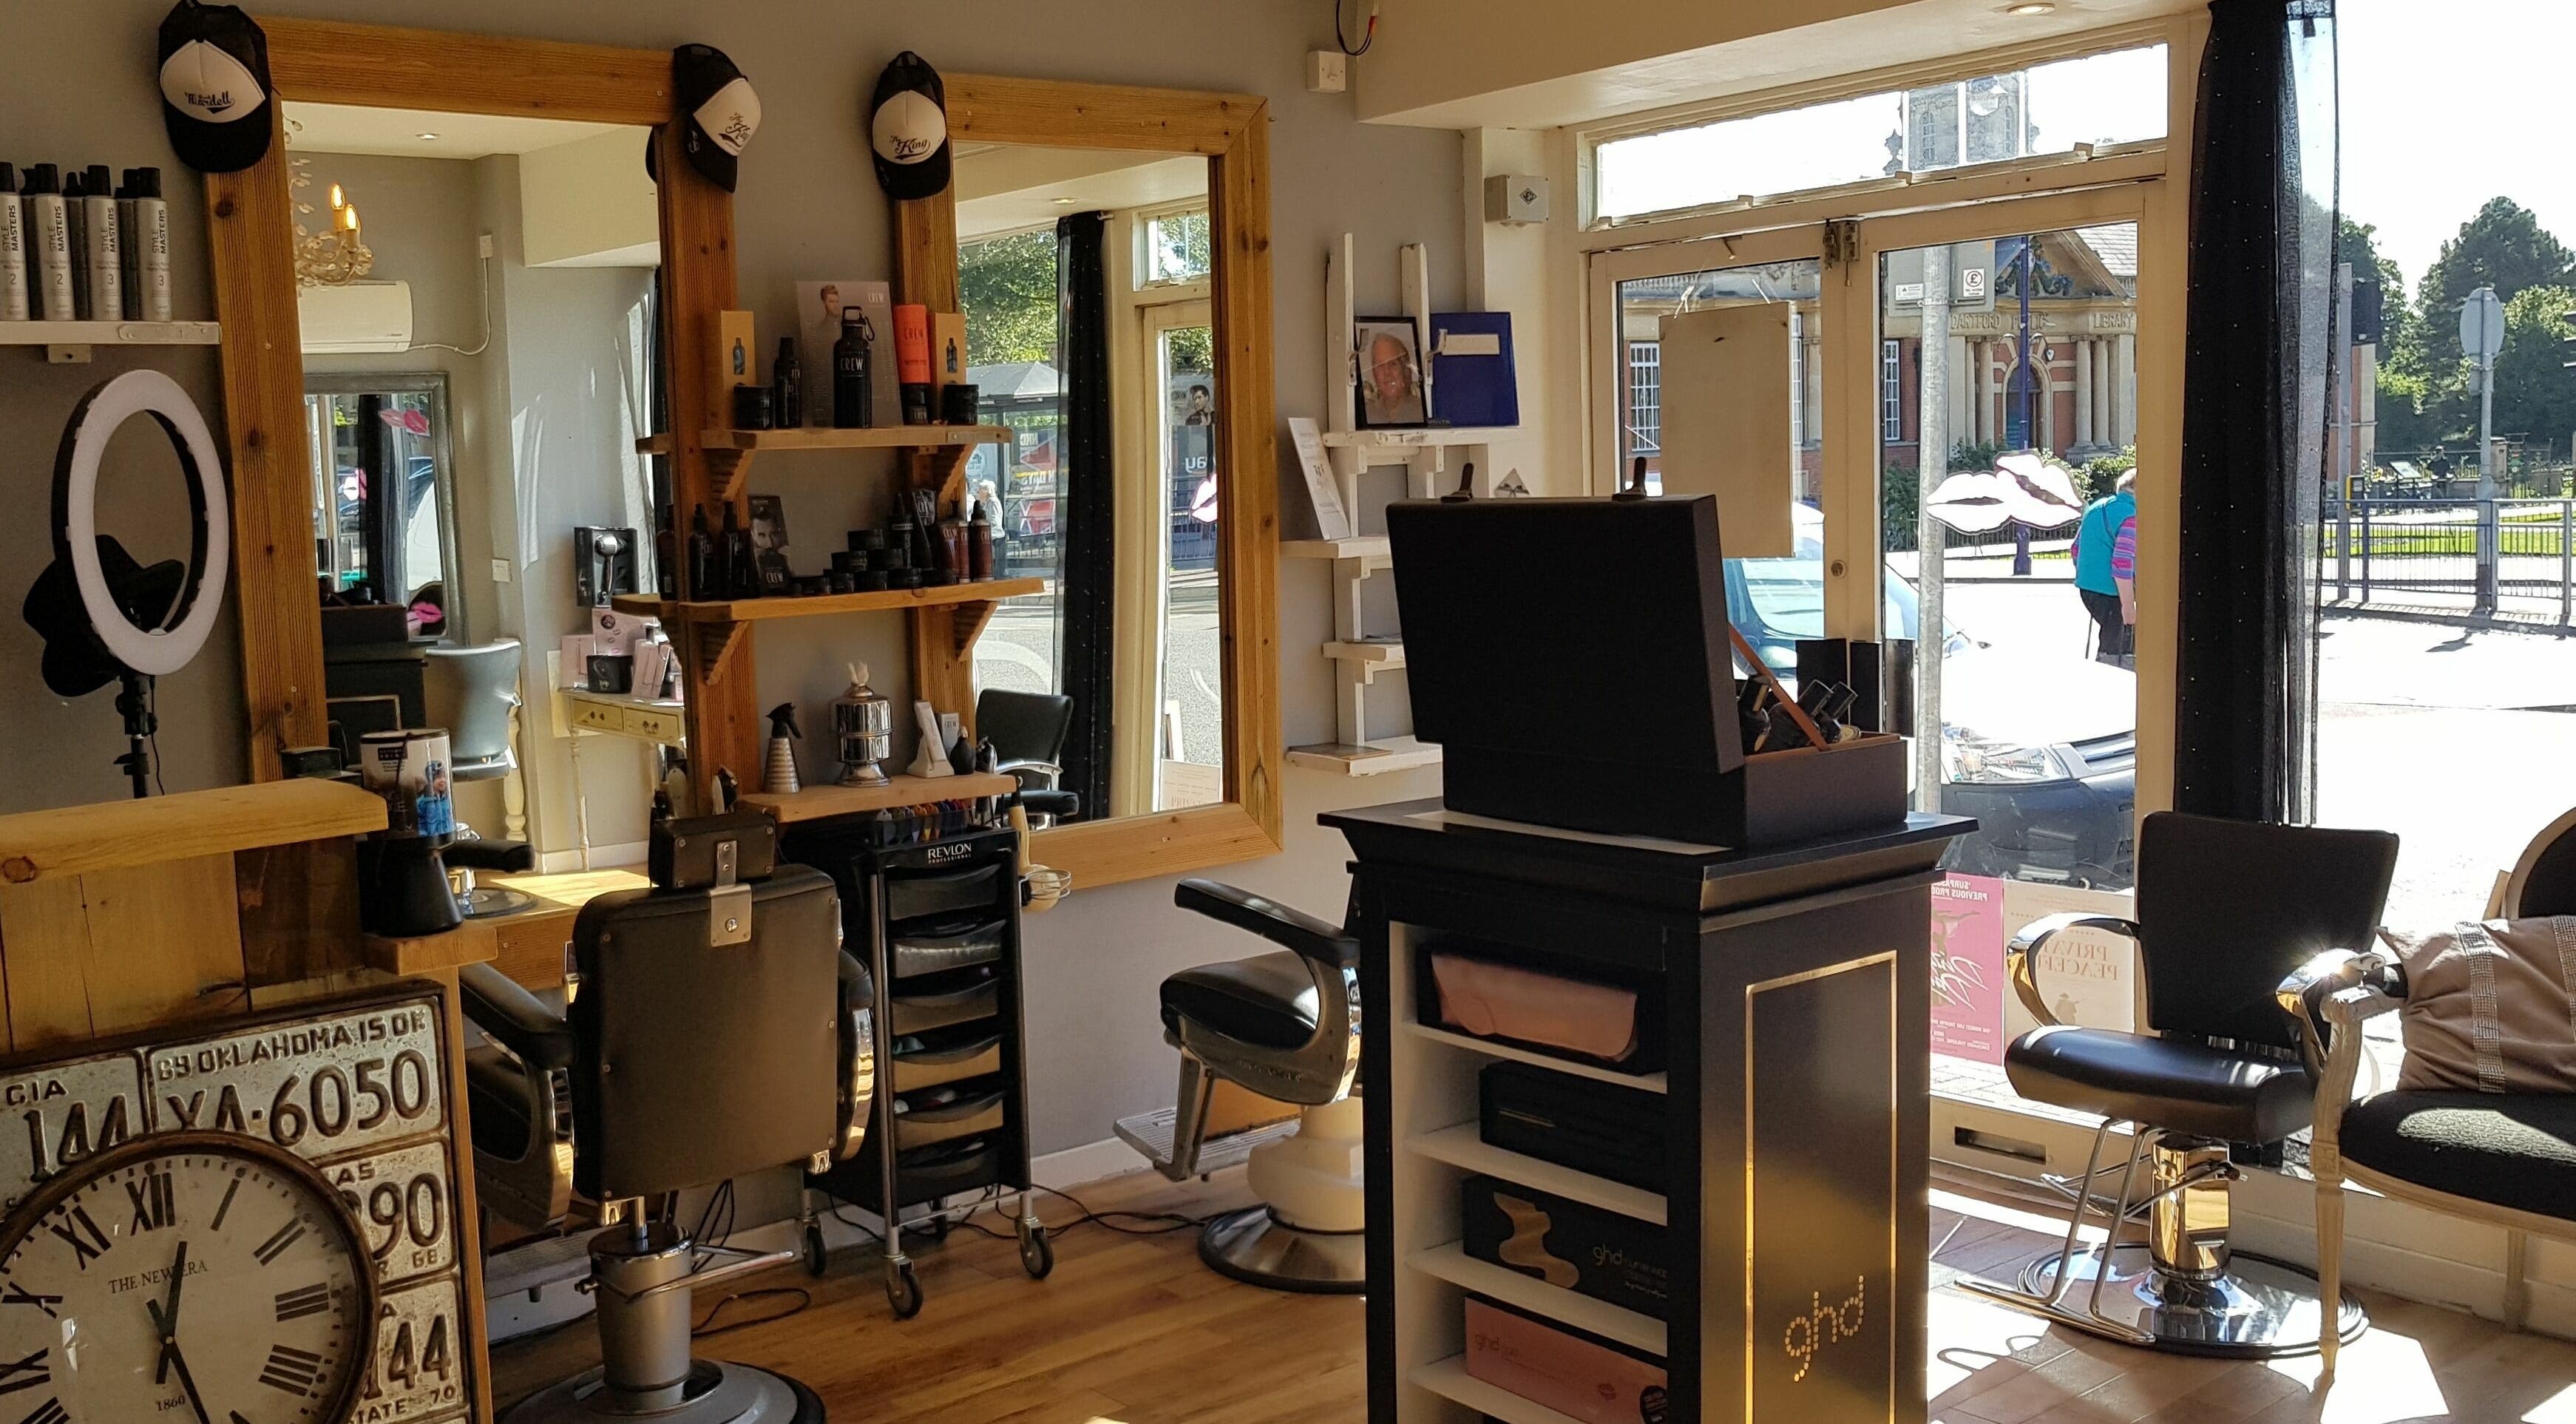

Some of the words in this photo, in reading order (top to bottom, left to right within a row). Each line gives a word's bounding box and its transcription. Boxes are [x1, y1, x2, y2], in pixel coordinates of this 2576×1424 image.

[895, 138, 928, 155] King
[1, 224, 10, 252] STYLE
[9, 205, 18, 251] MASTERS
[47, 225, 57, 251] STYLE
[55, 206, 65, 252] MASTERS
[101, 227, 109, 253] STYLE
[108, 207, 116, 253] MASTERS
[158, 209, 166, 254] MASTERS
[152, 230, 160, 254] STYLE
[10, 274, 17, 285] 2
[57, 274, 64, 285] 2
[108, 274, 114, 285] 3
[159, 275, 164, 286] 3
[1950, 312, 2001, 328] DARTFORD
[2093, 313, 2135, 328] LIBRARY
[840, 356, 864, 372] CREW
[928, 843, 972, 859] REVLON
[198, 1025, 353, 1074] OKLAHOMA
[359, 1017, 387, 1042] IS
[1593, 1243, 1623, 1267] ghd
[108, 1276, 138, 1294] THE
[141, 1266, 174, 1286] NEW
[1785, 1274, 1865, 1383] ghd
[1474, 1333, 1500, 1352] ghd
[155, 1394, 186, 1412] 1860
[429, 1384, 456, 1404] 70
